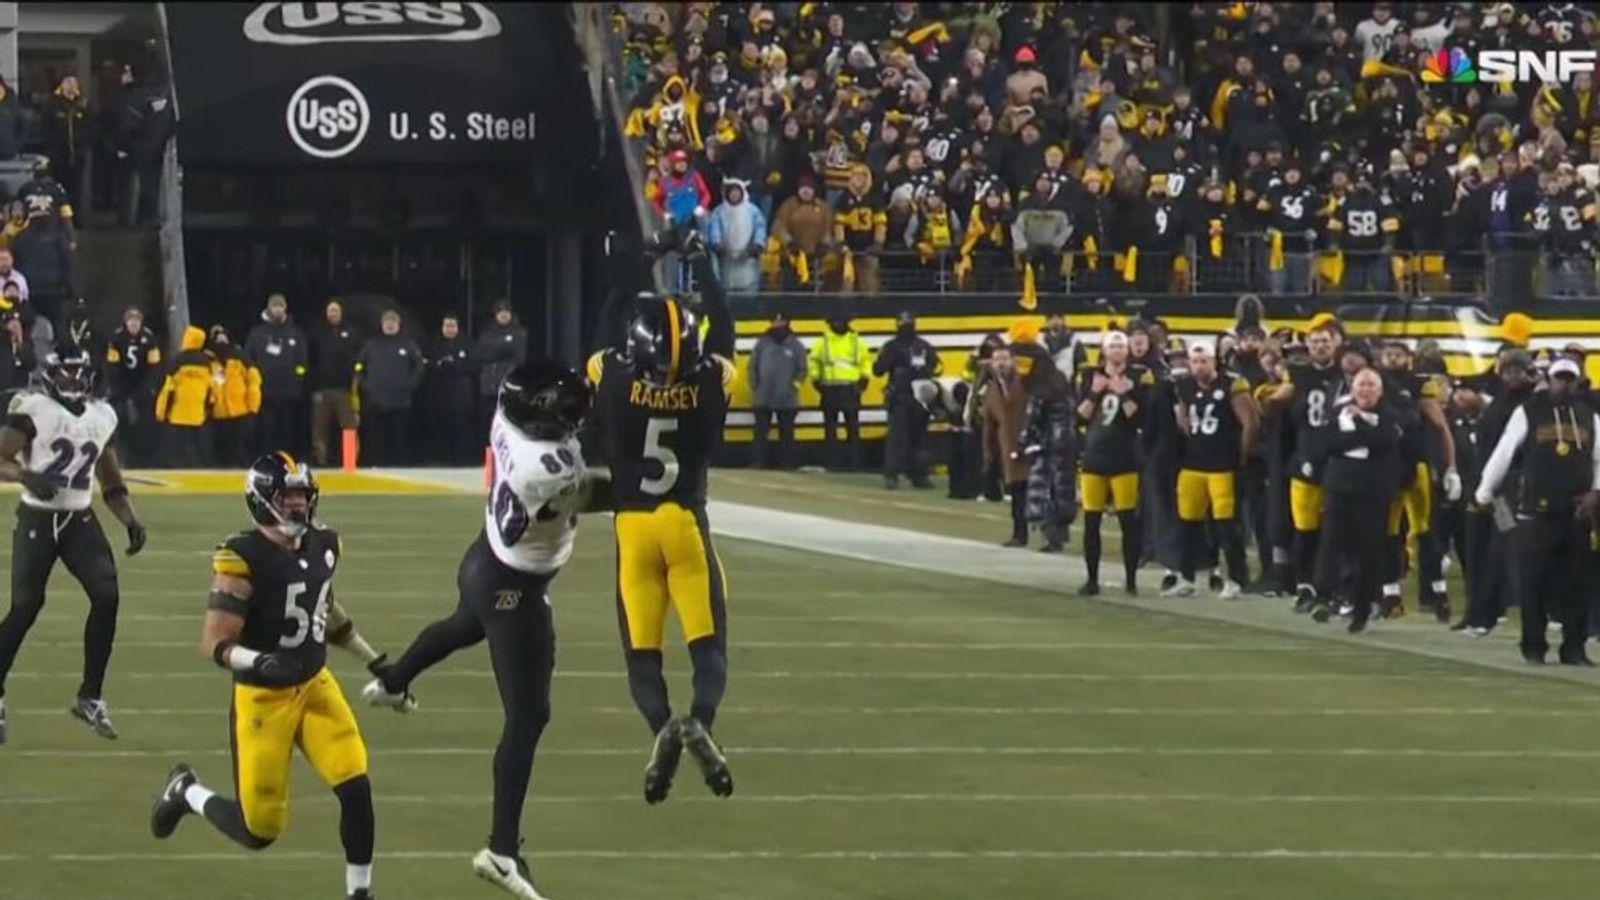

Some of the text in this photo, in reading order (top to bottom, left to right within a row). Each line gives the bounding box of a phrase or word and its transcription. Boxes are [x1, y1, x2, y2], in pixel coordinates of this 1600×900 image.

[298, 98, 358, 139] USS
[466, 112, 536, 140] Steel
[1155, 206, 1168, 235] 9
[1280, 195, 1304, 219] 56
[1347, 210, 1377, 237] 58
[125, 346, 138, 369] 5
[629, 380, 700, 410] RAMSEY
[1102, 394, 1120, 426] 9
[1307, 389, 1326, 427] 8
[43, 437, 99, 490] 22
[540, 447, 575, 475] 80
[639, 417, 680, 496] 5
[278, 581, 331, 648] 56
